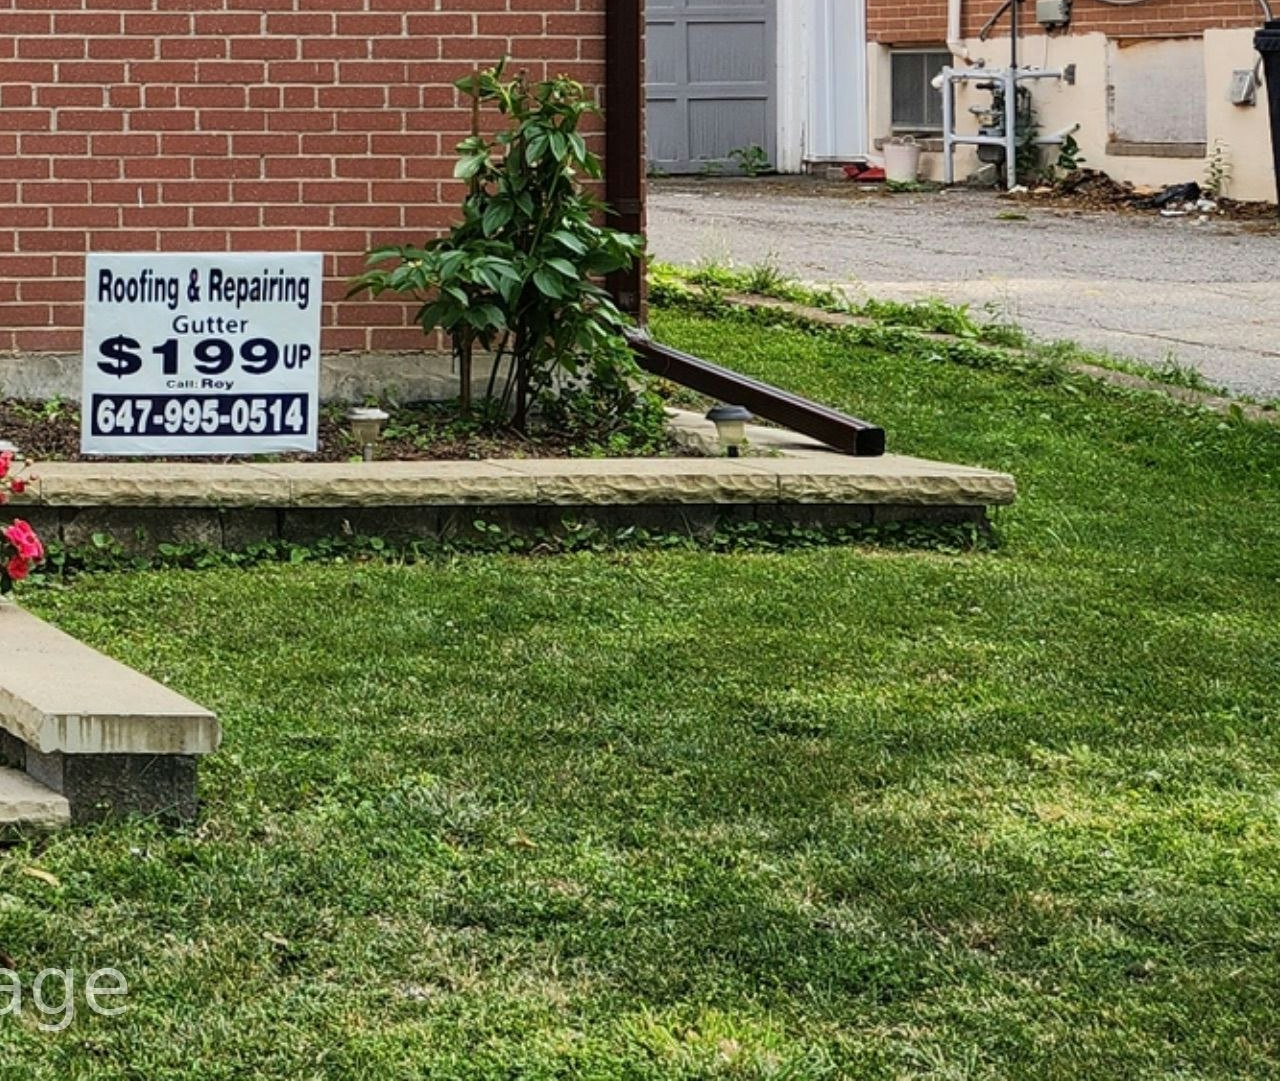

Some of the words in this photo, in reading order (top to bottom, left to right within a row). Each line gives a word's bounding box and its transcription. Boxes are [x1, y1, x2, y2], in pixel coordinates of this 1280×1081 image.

[98, 269, 179, 310] Roofing
[187, 267, 200, 302] &
[208, 268, 310, 310] Repairing
[172, 315, 248, 334] Gutter
[97, 334, 280, 379] $199
[283, 344, 311, 369] UP
[166, 379, 198, 389] Call:
[201, 378, 234, 390] Roy
[96, 398, 304, 434] 647-995-0514
